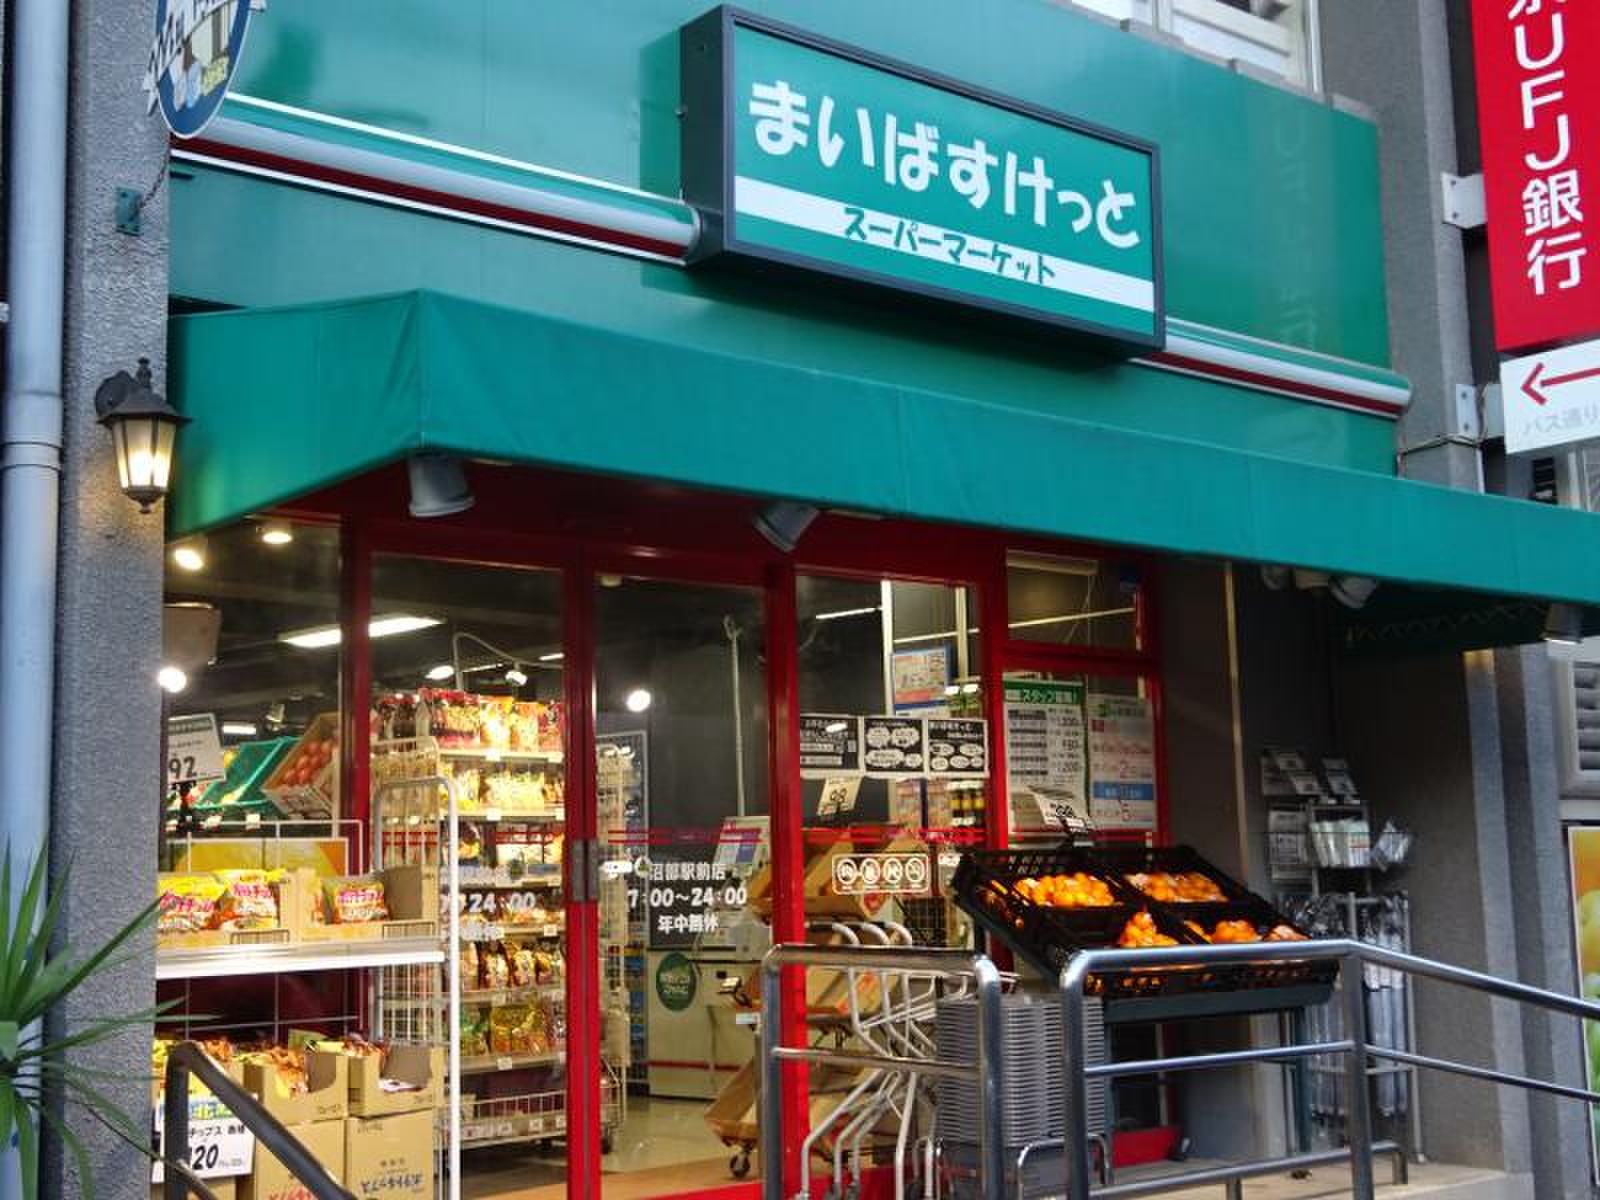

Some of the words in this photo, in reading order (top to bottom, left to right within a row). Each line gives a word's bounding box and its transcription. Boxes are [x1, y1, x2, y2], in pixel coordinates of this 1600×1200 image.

[748, 79, 1140, 249] まいばすけっと
[843, 206, 1056, 285] スーパーマーケット
